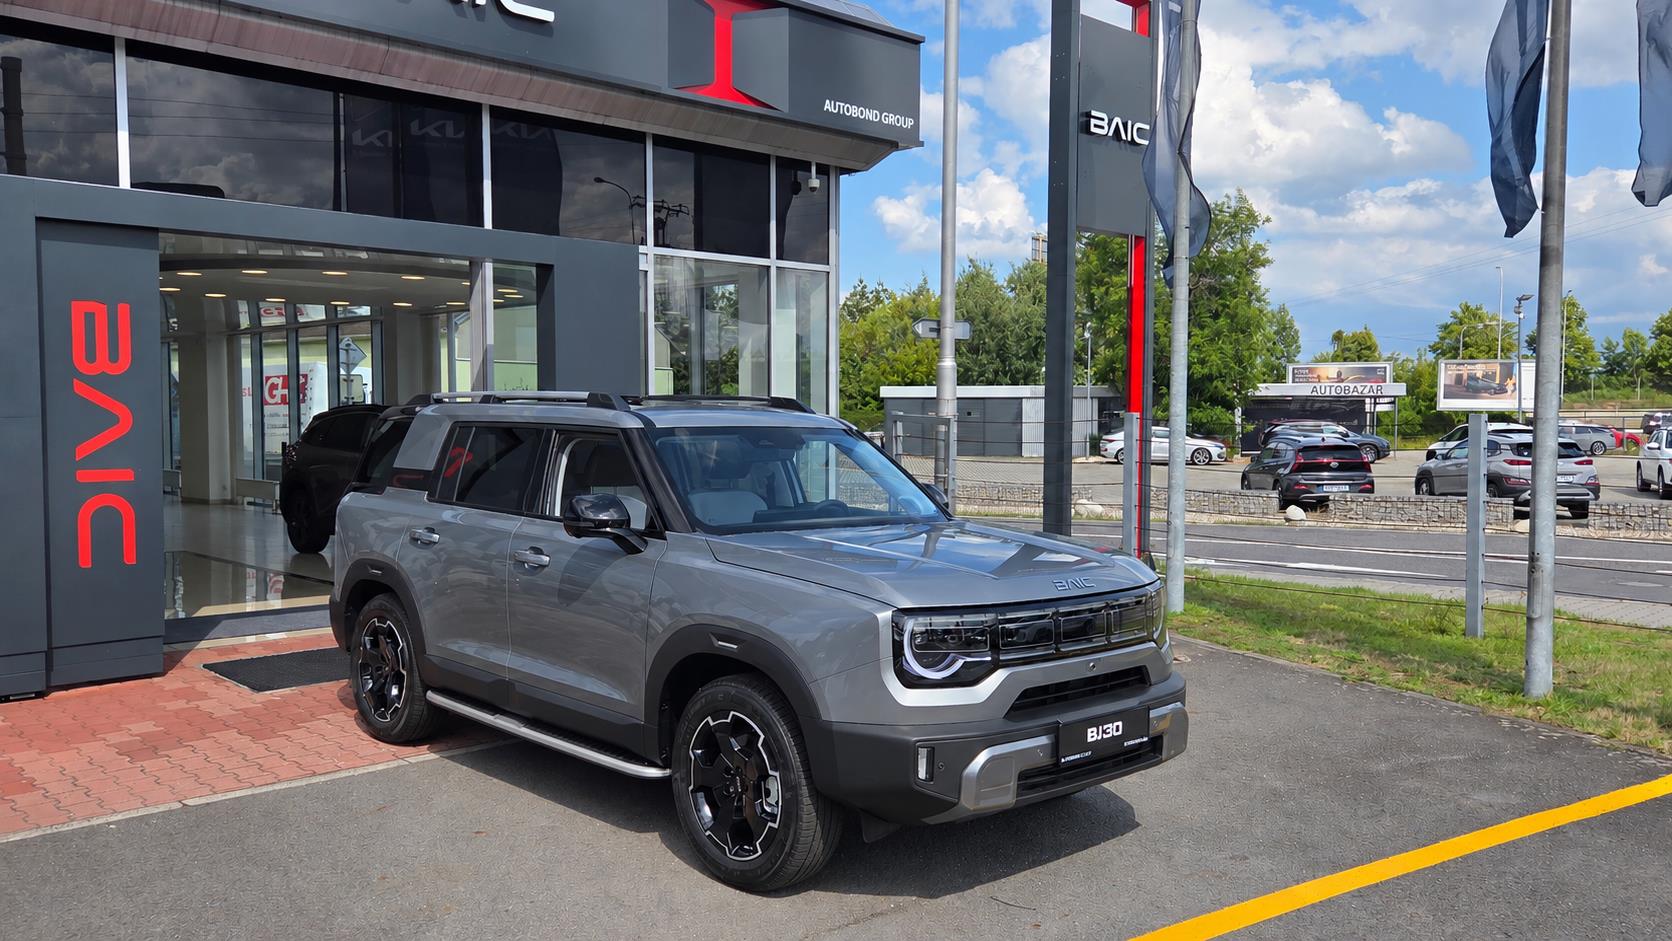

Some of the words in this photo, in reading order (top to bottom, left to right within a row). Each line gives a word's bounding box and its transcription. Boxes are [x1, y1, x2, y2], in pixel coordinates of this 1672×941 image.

[823, 99, 880, 122] AUTOBOND
[881, 112, 914, 129] GROUP
[1089, 109, 1150, 146] BAIC
[1311, 384, 1383, 395] AUTOBAZAR
[71, 300, 136, 569] BAIC
[1052, 576, 1097, 591] BAIC
[1087, 721, 1123, 743] BJ30
